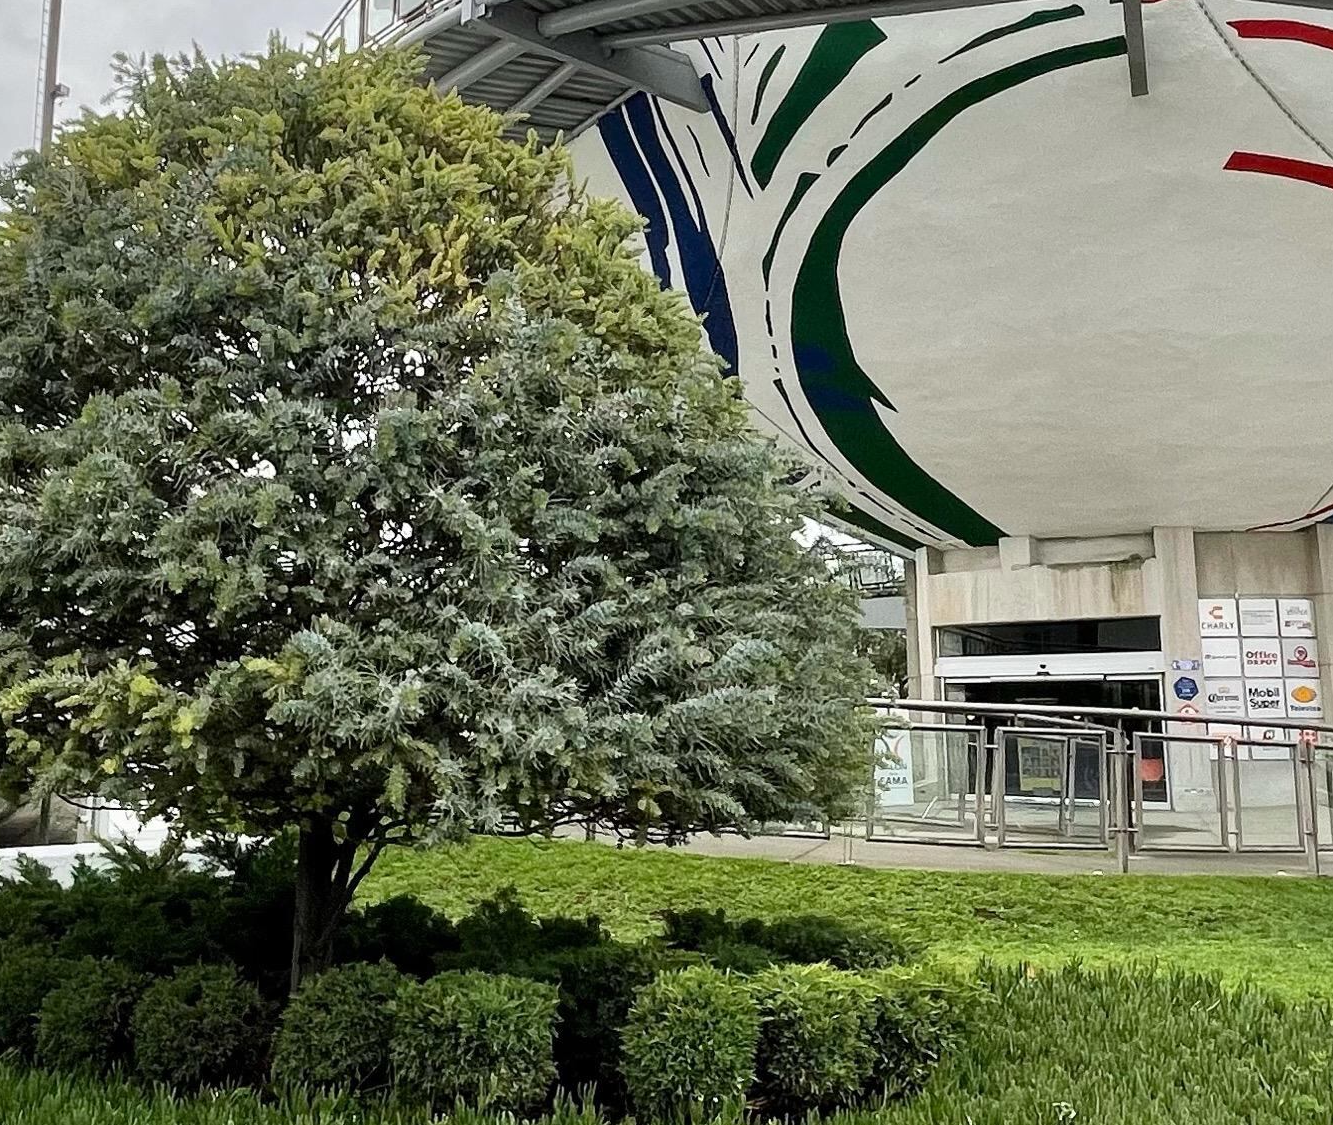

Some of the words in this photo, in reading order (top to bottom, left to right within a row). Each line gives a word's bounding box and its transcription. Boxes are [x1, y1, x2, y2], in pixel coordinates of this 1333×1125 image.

[1201, 621, 1235, 630] CHARLY
[1246, 651, 1277, 659] Office
[1248, 687, 1280, 698] Mobil
[1249, 698, 1280, 710] Super
